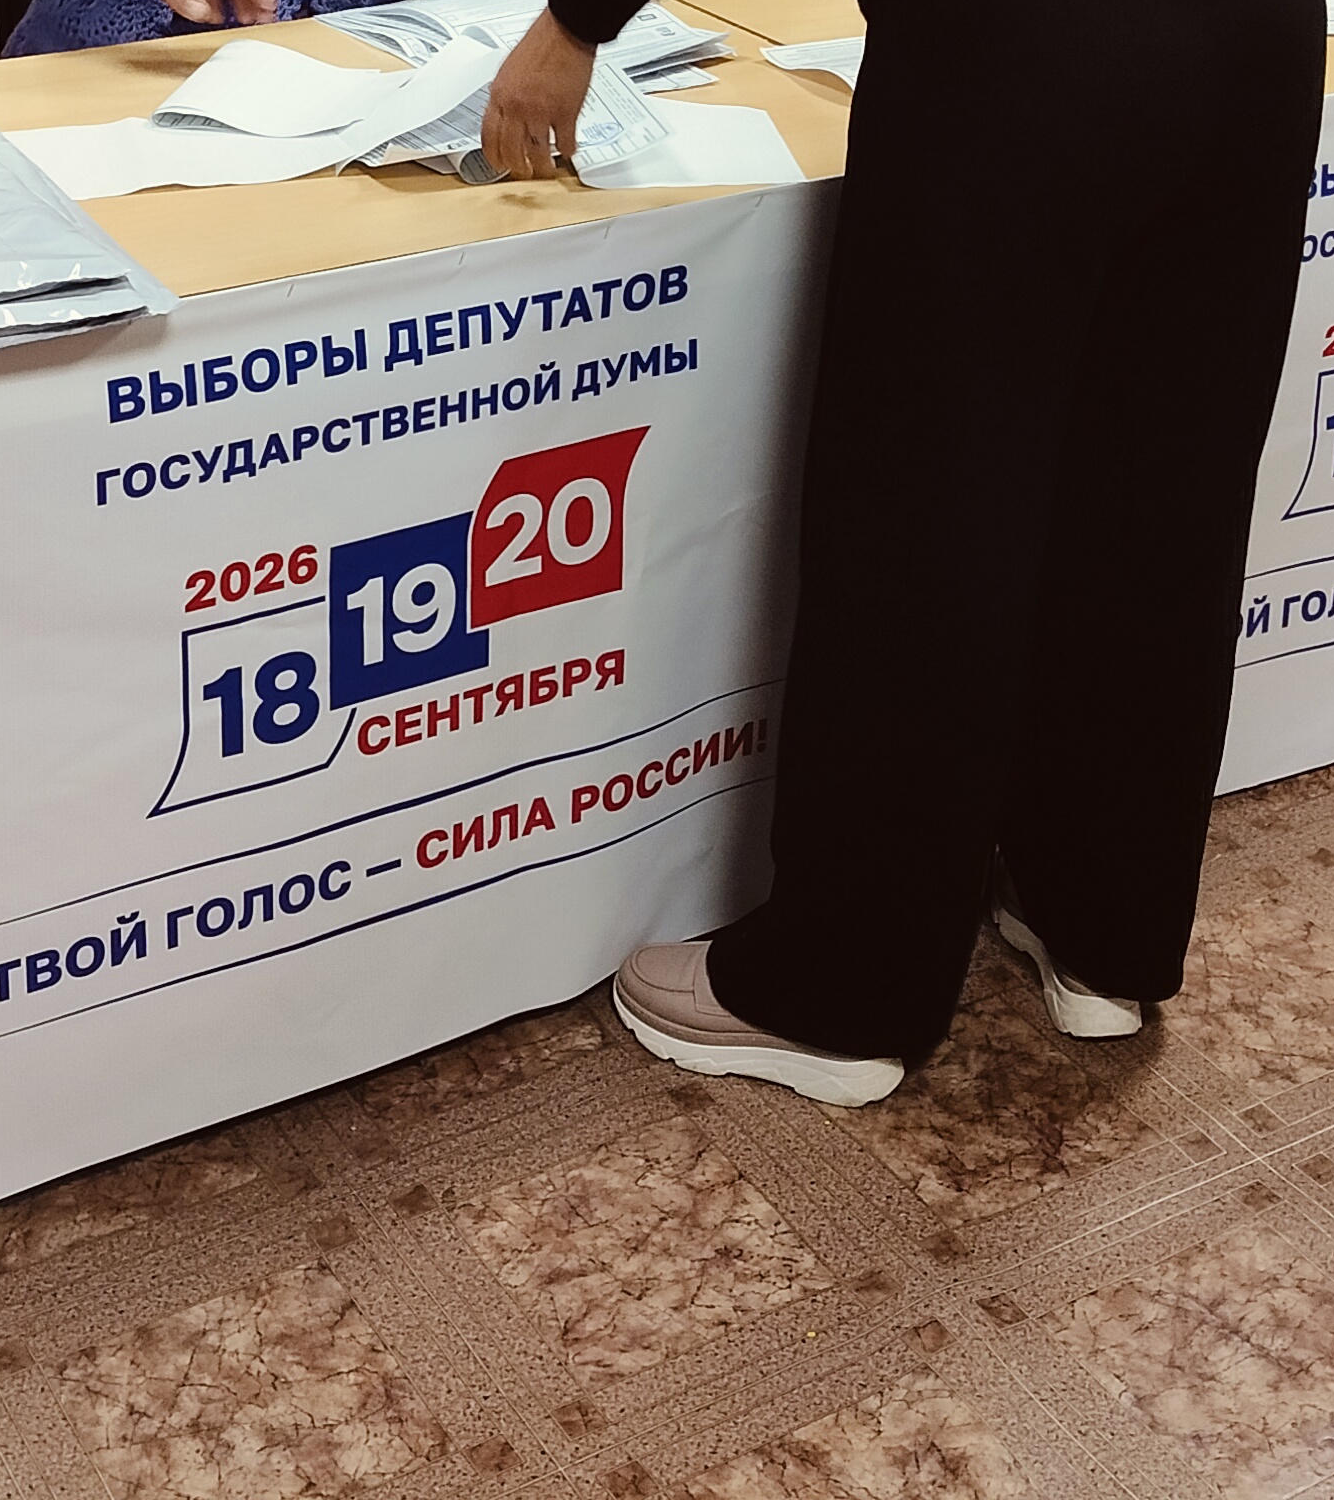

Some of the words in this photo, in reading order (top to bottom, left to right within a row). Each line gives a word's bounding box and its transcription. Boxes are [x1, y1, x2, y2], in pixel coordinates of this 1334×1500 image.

[107, 328, 369, 425] ВЫБОРЫ
[384, 265, 690, 373] ДЕПУТАТОВ
[95, 361, 561, 506] ГОСУДАРСТВЕННОЙ
[570, 338, 699, 403] ДУМЫ
[184, 544, 319, 613] 2026
[484, 477, 612, 587] 20
[346, 562, 458, 666] 19
[203, 651, 320, 759] 18
[356, 648, 627, 756] СЕНТЯБРЯ
[166, 860, 353, 950] ГОЛОС
[415, 797, 557, 870] СИЛА
[570, 718, 769, 825] РОССИИ!
